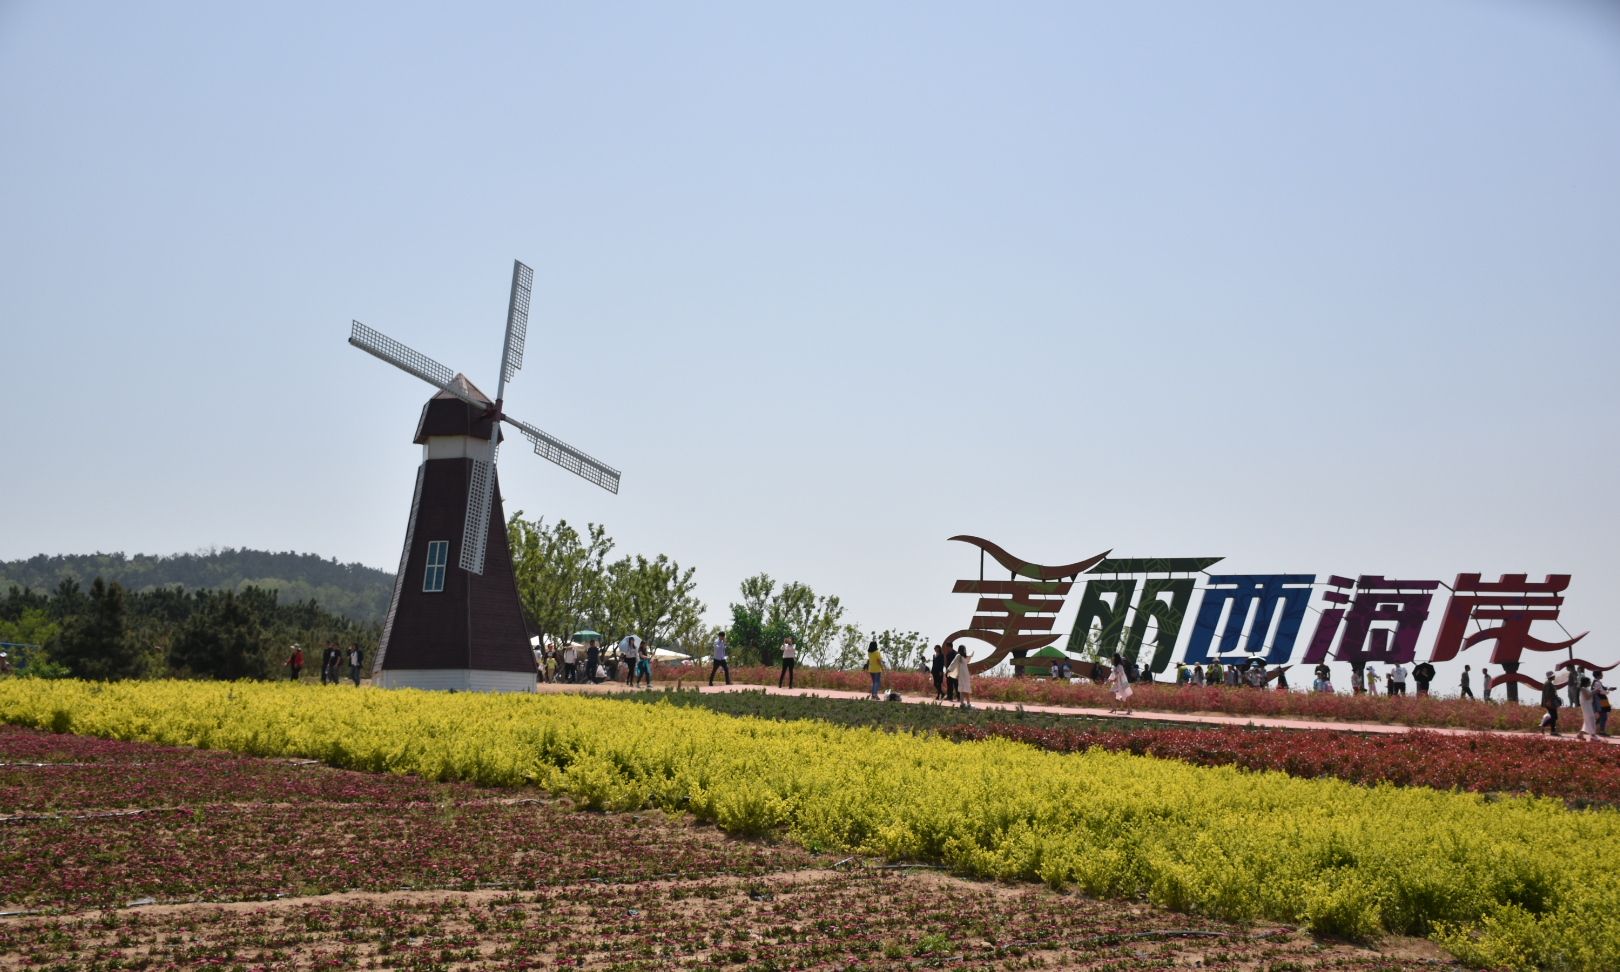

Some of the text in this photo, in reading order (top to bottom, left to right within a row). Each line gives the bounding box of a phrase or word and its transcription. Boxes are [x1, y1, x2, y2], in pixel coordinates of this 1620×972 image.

[944, 535, 1590, 682] 美丽西海岸
